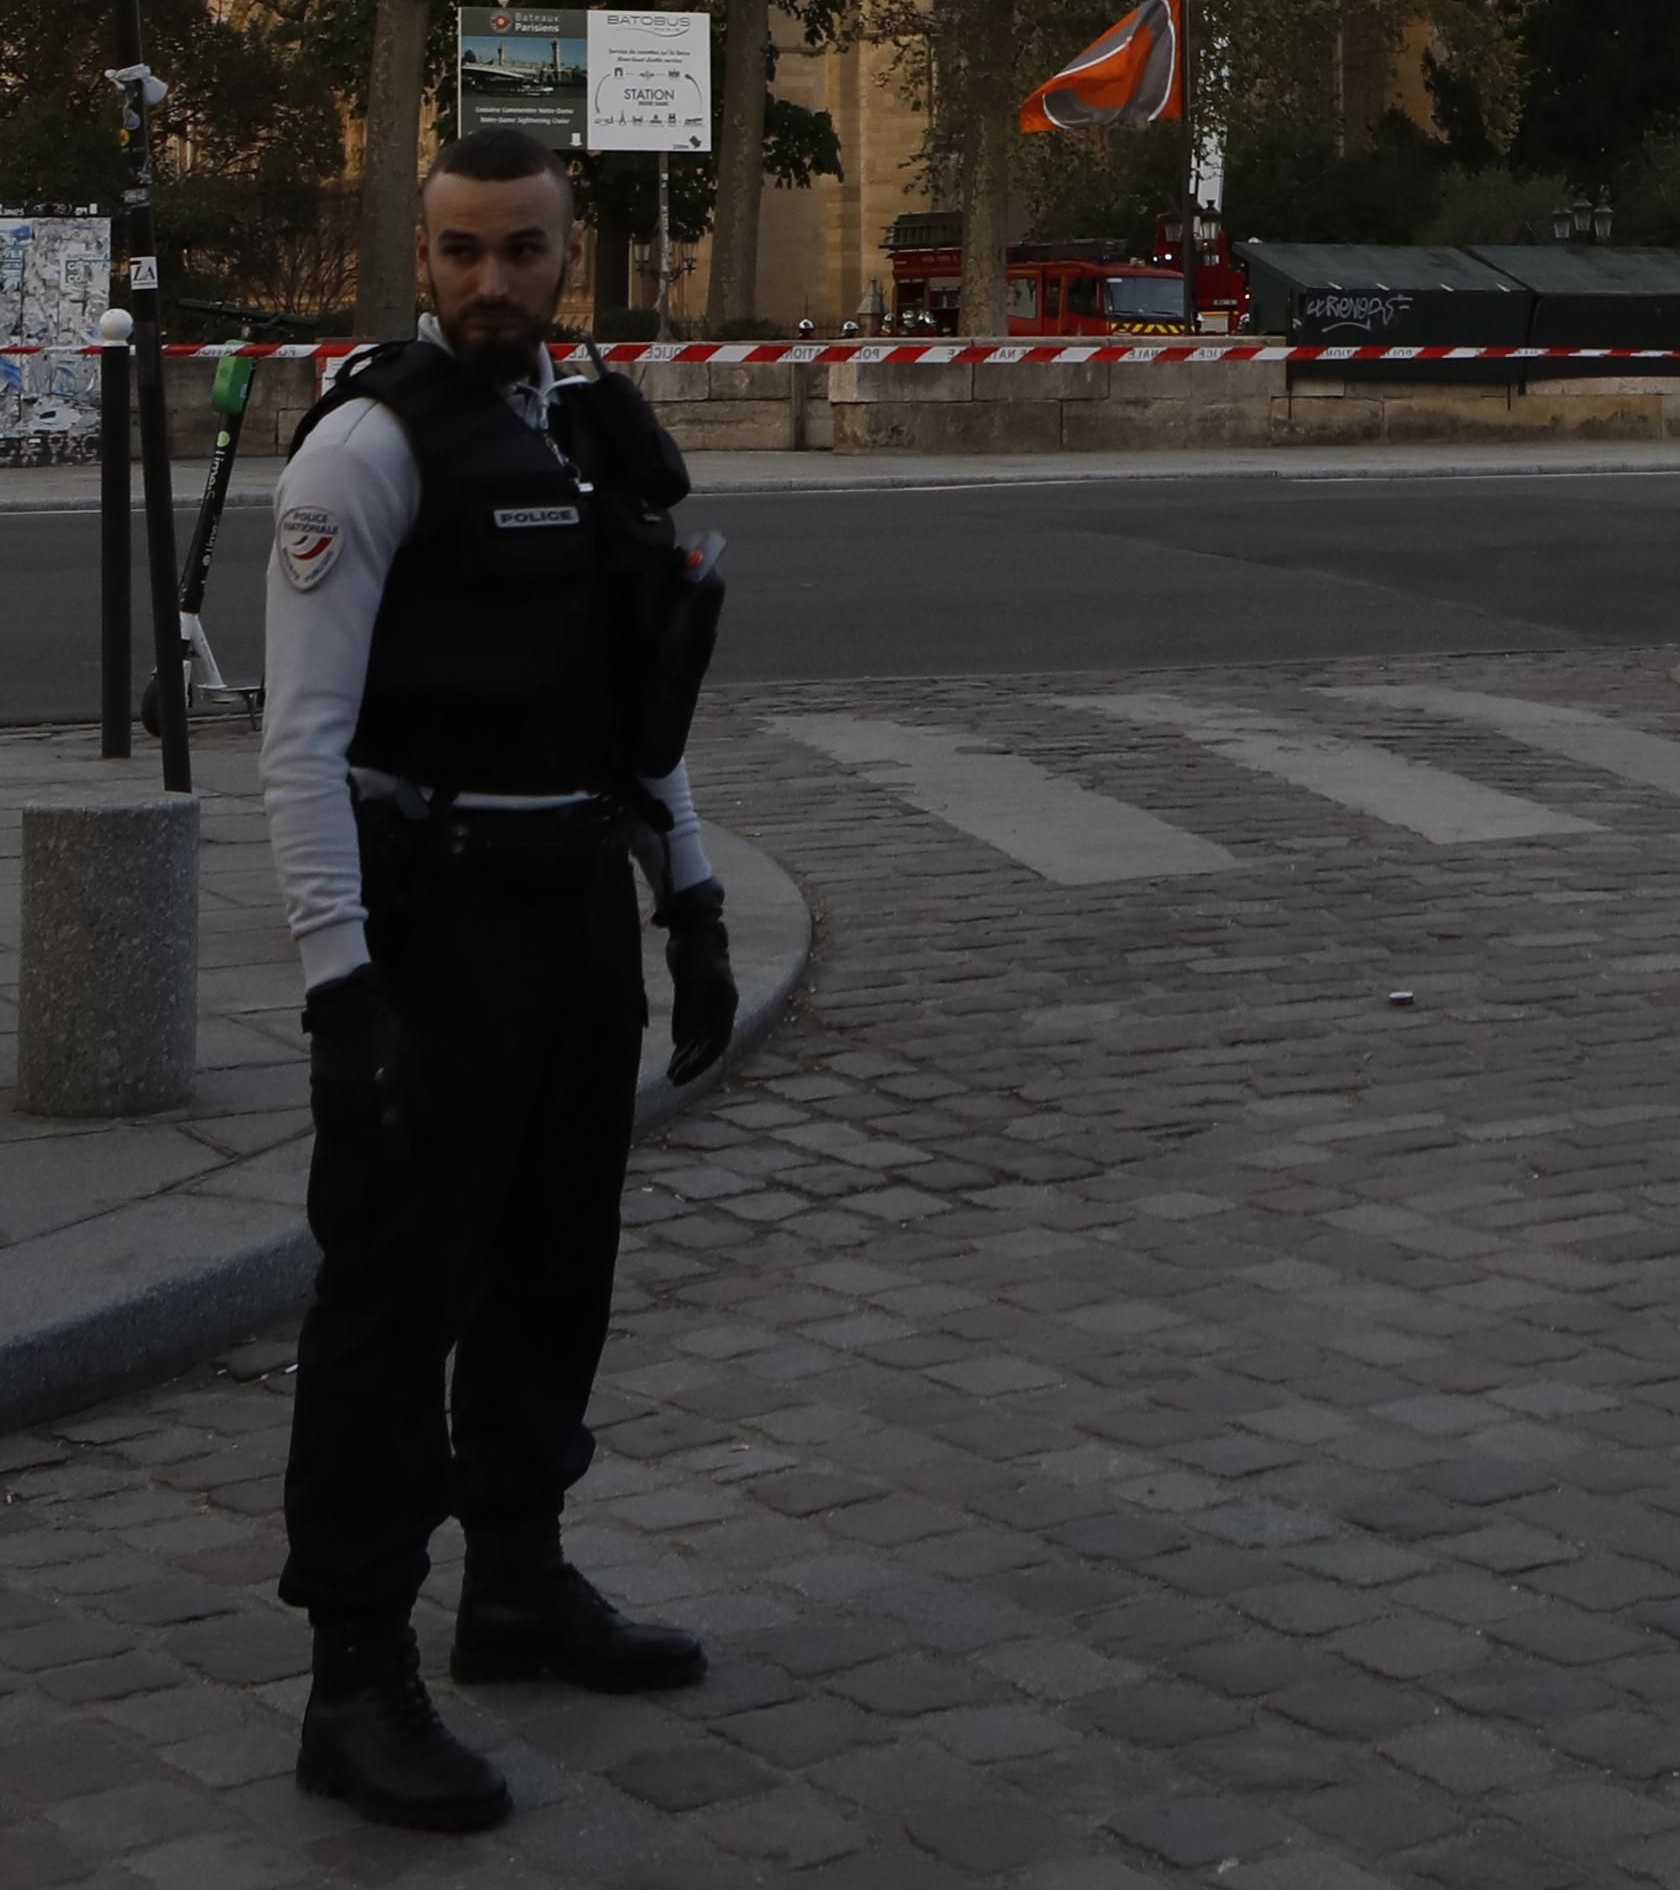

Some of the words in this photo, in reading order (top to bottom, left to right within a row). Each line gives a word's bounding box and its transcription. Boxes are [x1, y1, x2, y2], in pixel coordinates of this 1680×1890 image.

[515, 12, 560, 22] Bateaux
[607, 14, 691, 27] BATOBUS
[515, 22, 560, 33] Parisiens
[623, 88, 675, 101] STATION
[293, 512, 328, 523] POLICE
[500, 511, 573, 523] POLICE
[283, 522, 339, 536] NATIONALE
